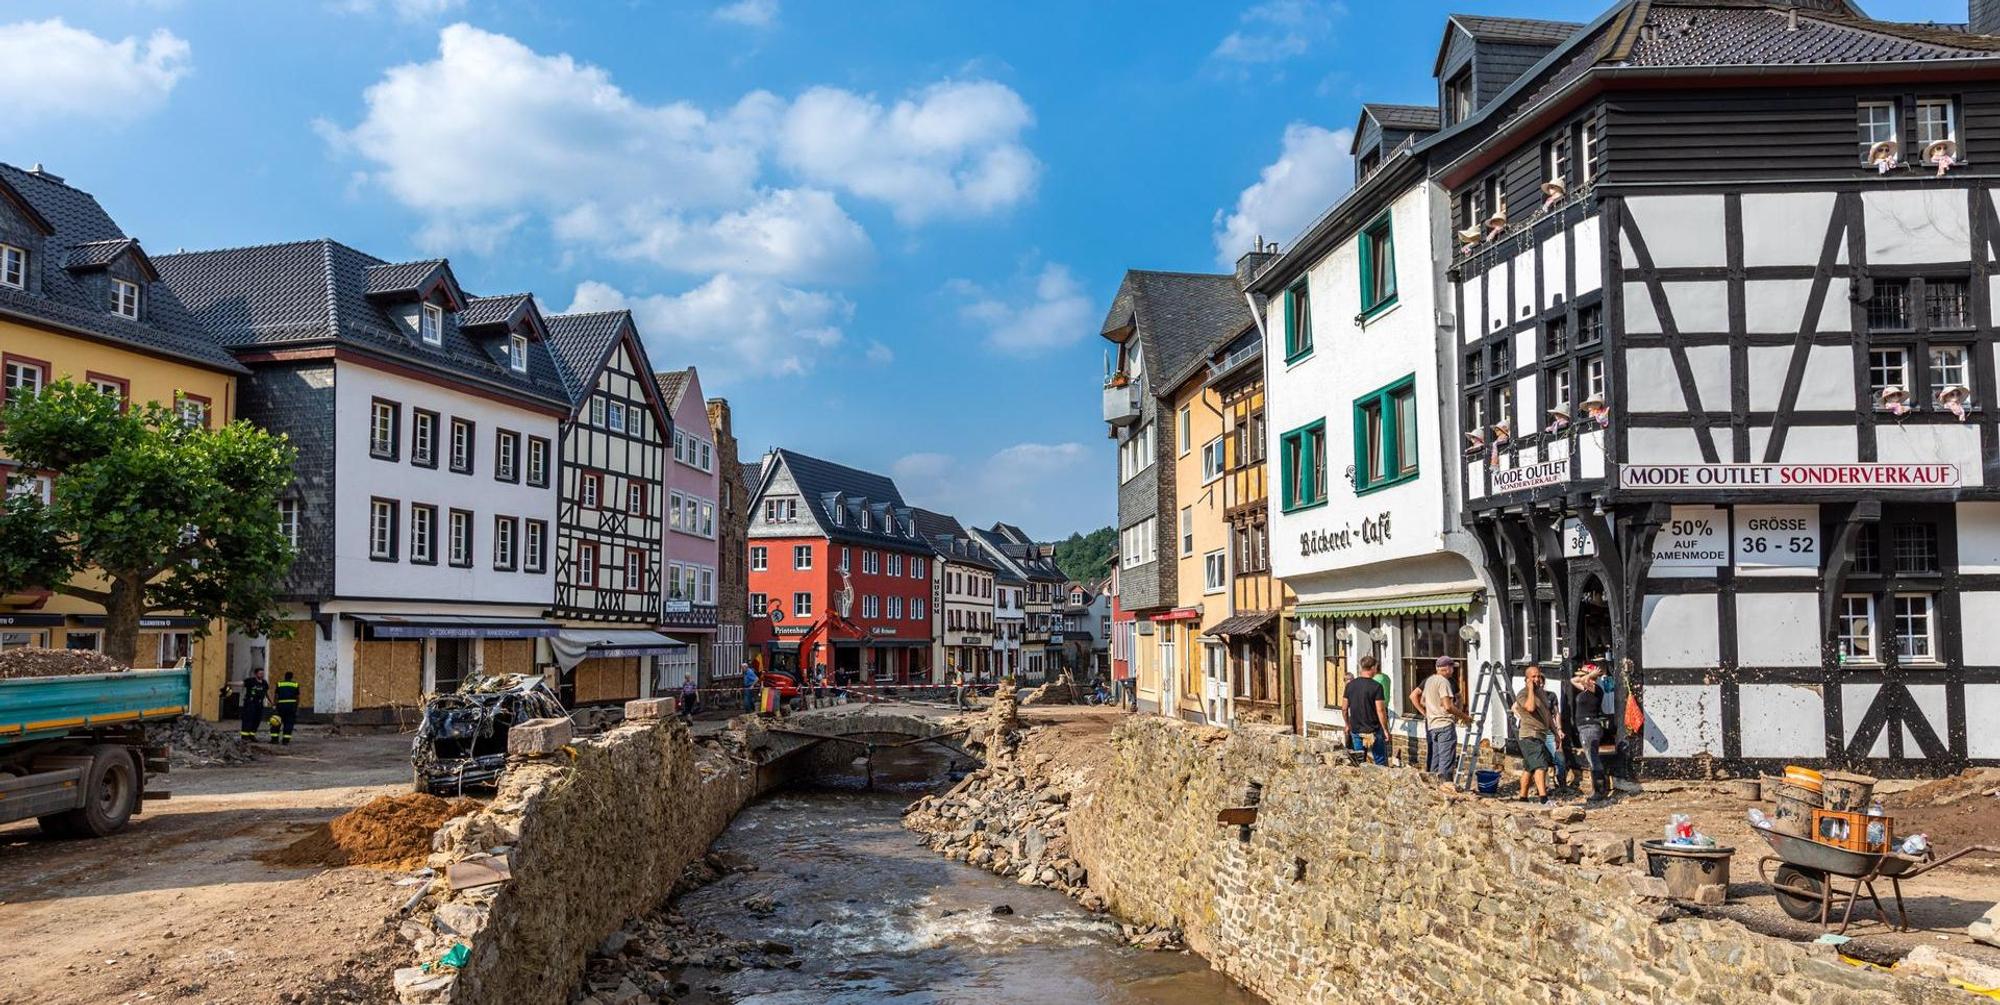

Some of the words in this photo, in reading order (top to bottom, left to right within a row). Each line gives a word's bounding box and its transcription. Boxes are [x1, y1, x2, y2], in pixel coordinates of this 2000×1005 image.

[1493, 469, 1523, 486] MODE
[1526, 460, 1567, 480] OUTLET
[1629, 467, 1689, 485] MODE
[1696, 467, 1773, 485] OUTLET
[1780, 466, 1951, 485] SONDERVERKAUF
[1500, 474, 1559, 491] SONDERVERKAUF
[1672, 519, 1713, 536] 50%
[1748, 517, 1807, 531] GRÖSSE
[1572, 536, 1584, 550] 36
[1674, 540, 1698, 549] AUF
[1742, 537, 1767, 553] 36
[1789, 536, 1814, 553] 52
